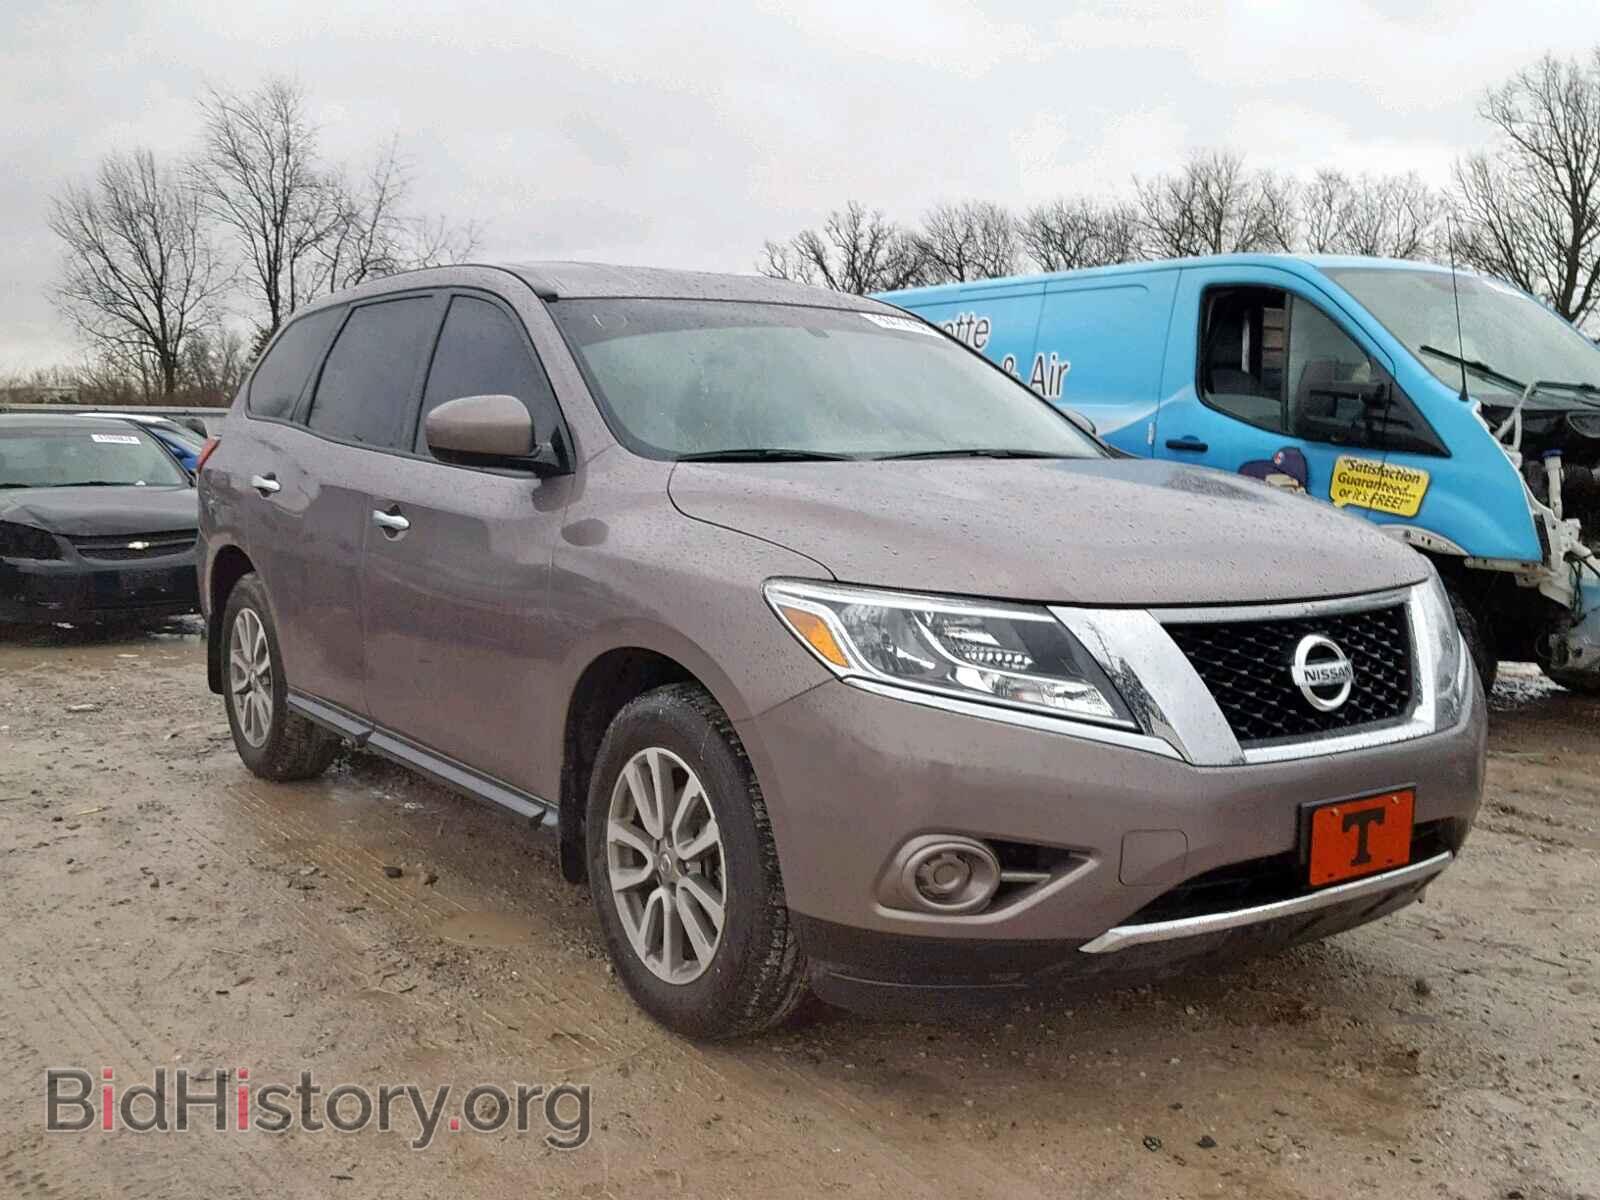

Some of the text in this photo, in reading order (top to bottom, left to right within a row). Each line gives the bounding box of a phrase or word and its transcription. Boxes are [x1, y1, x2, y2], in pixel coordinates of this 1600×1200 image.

[1030, 354, 1069, 396] Air
[1339, 488, 1352, 498] or
[1304, 665, 1351, 682] NISSAN
[1342, 807, 1386, 866] T
